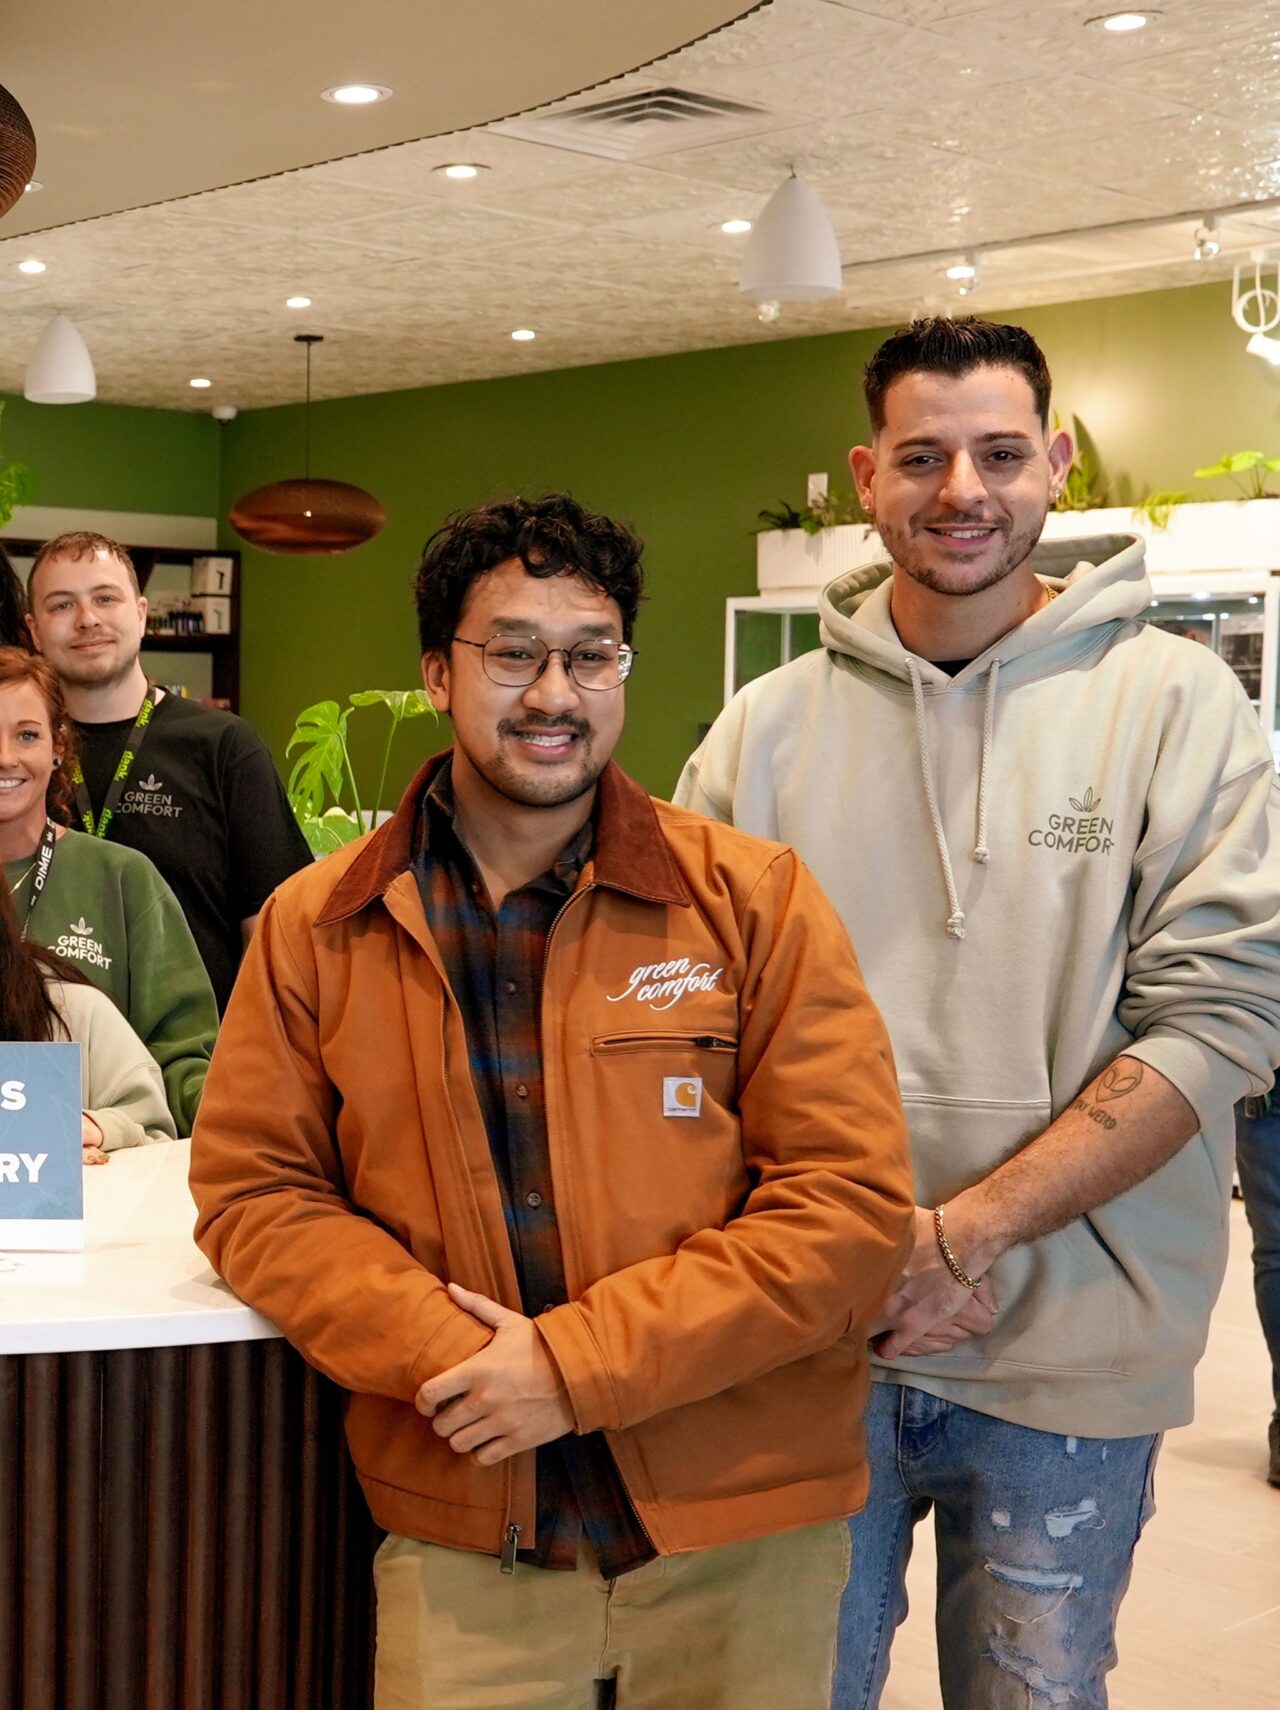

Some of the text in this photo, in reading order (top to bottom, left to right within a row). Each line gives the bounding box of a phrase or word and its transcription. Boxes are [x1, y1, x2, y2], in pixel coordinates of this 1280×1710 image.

[124, 791, 173, 806] GREEN
[1048, 814, 1115, 836] GREEN
[1028, 829, 1116, 856] COMFOR
[57, 934, 103, 954] GREEN
[606, 957, 691, 1002] green
[636, 962, 724, 1011] comfort
[1088, 1106, 1117, 1130] WEIRD
